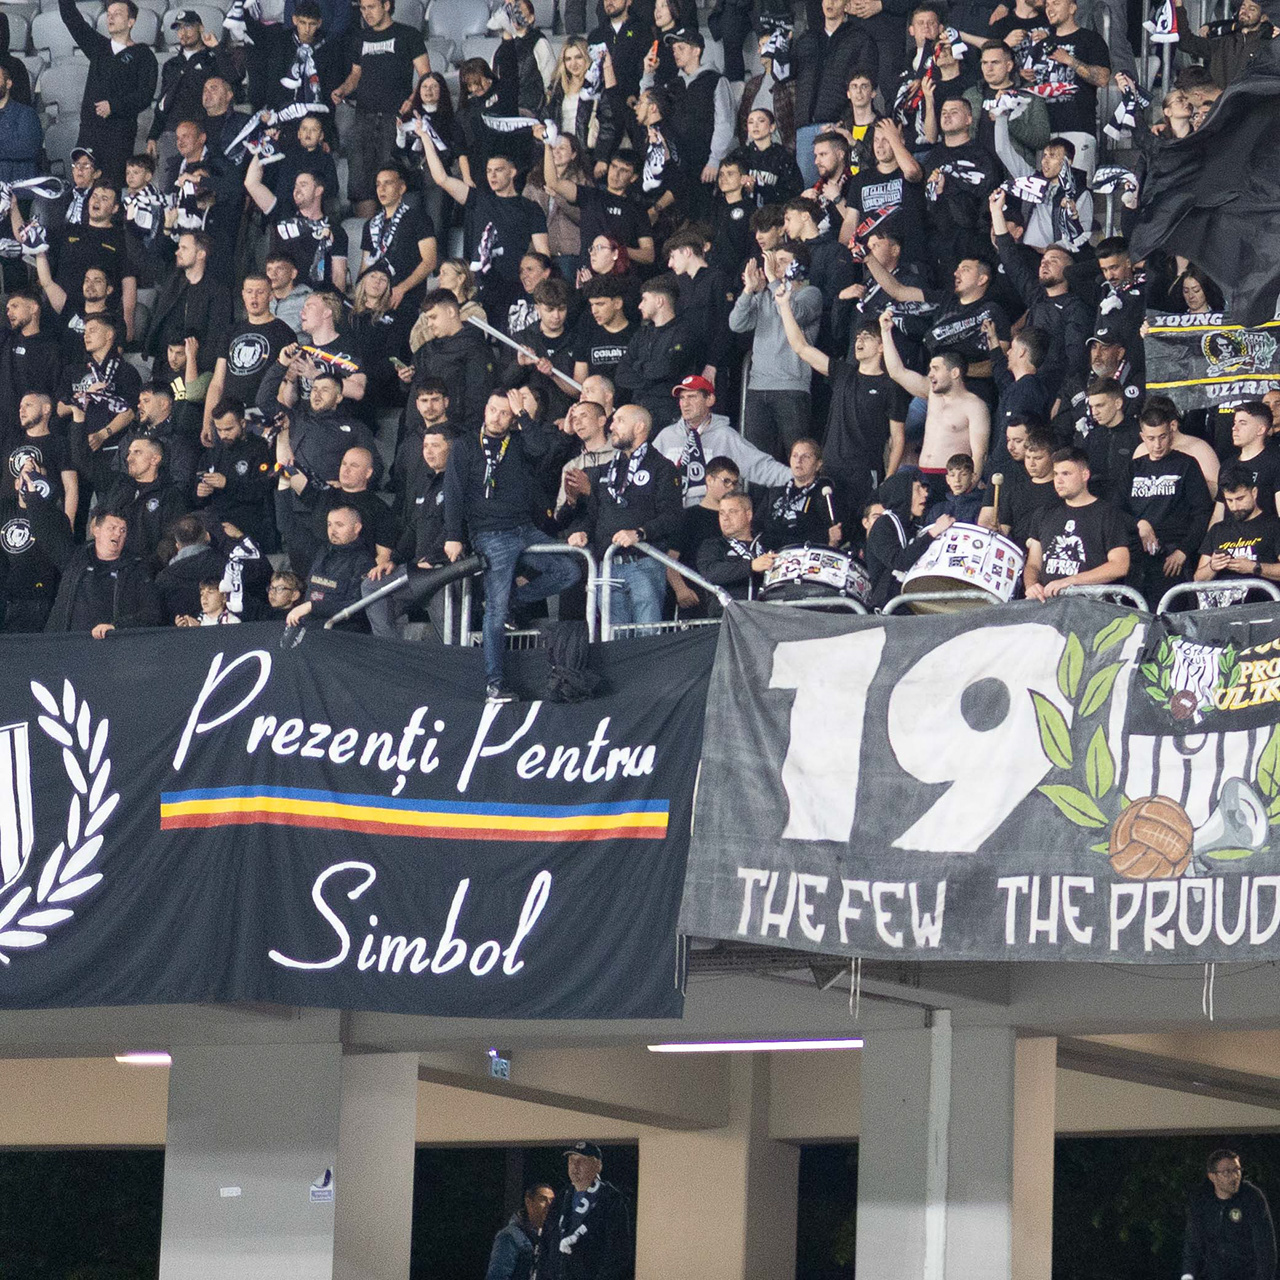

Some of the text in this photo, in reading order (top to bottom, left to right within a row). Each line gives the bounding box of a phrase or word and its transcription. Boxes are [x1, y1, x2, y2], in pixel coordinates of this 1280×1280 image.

[1155, 312, 1223, 327] YOUNG
[172, 649, 446, 796] Prezenți
[456, 699, 658, 793] Pentru
[768, 621, 1070, 853] 19
[268, 861, 553, 977] Simbol
[736, 867, 948, 948] THE FEW
[998, 874, 1106, 946] THE
